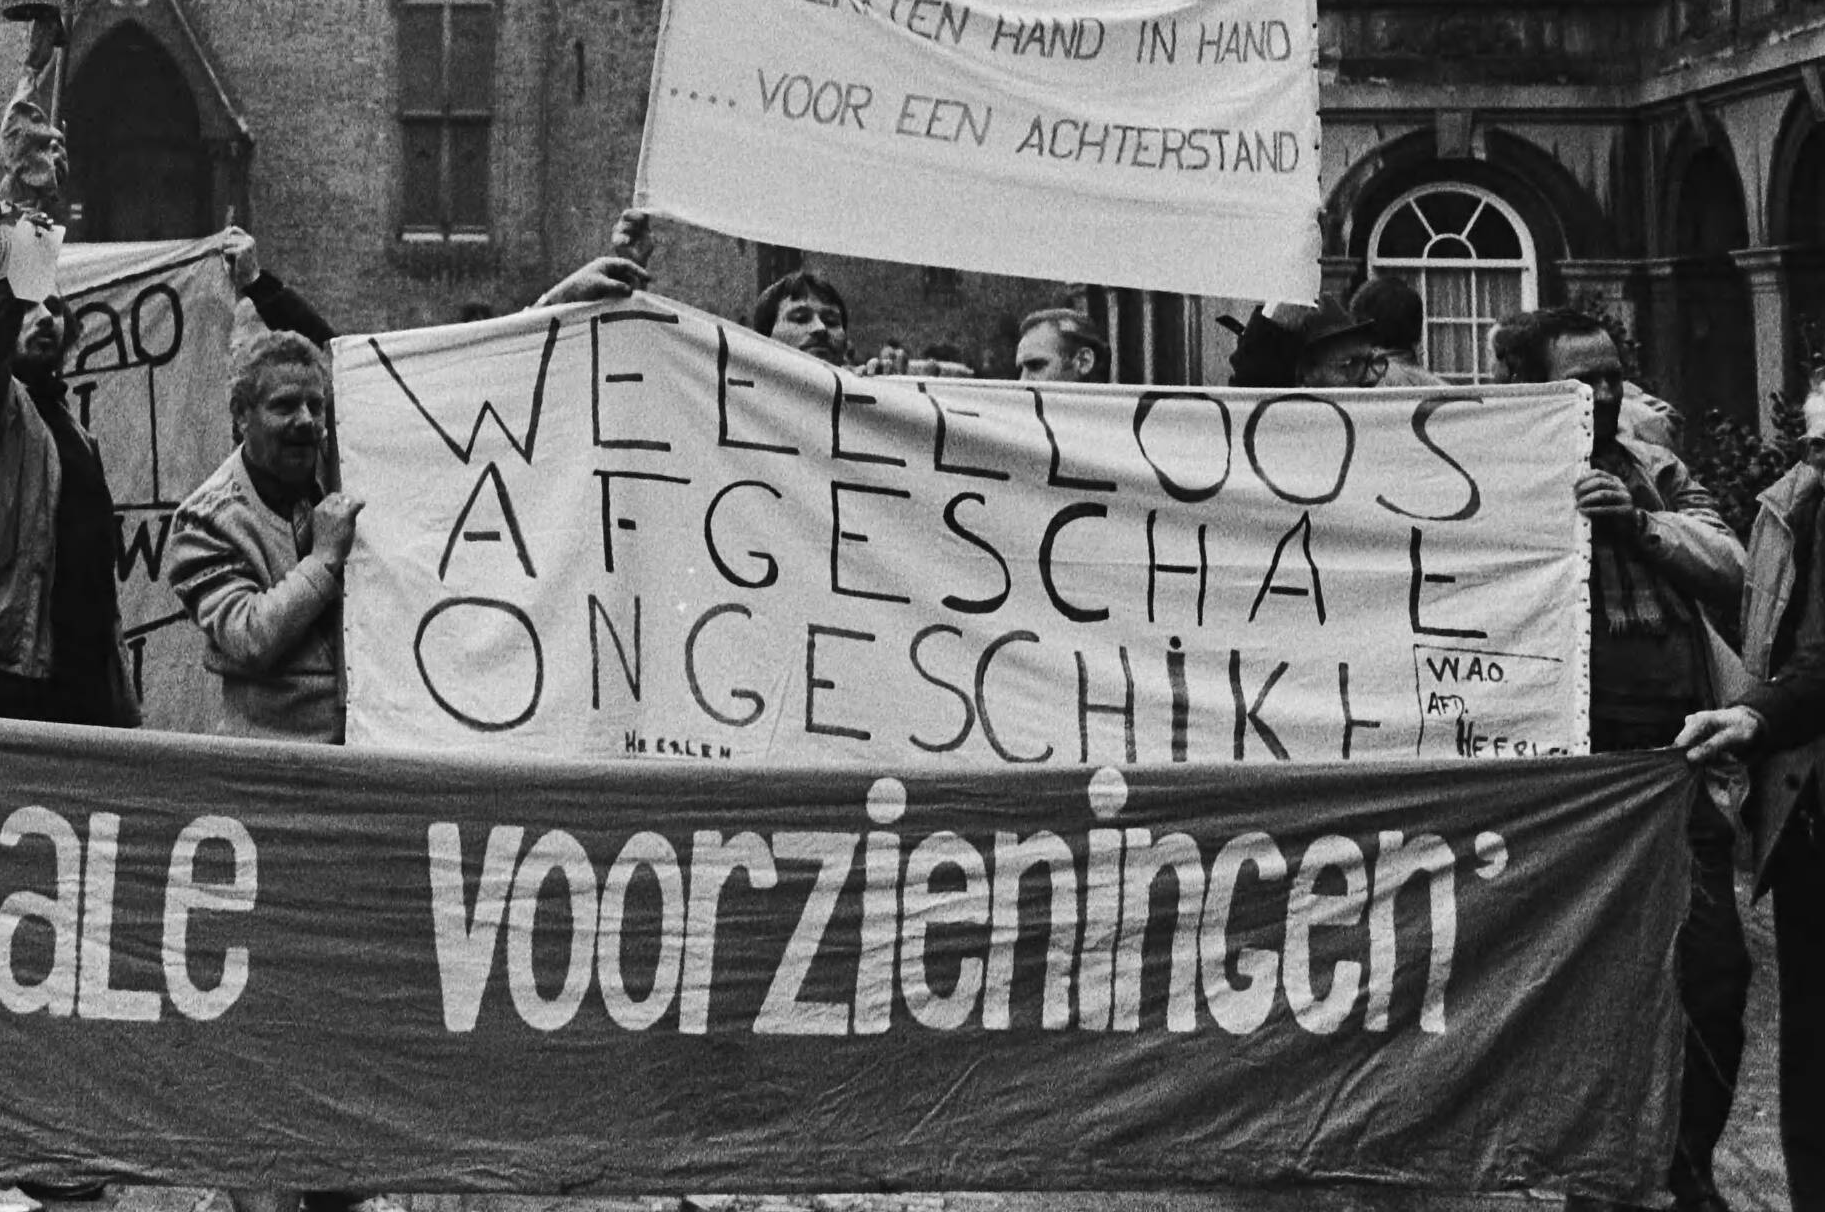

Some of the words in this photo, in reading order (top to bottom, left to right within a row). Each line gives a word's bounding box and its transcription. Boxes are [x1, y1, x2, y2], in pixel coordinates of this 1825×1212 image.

[990, 15, 1106, 61] HAND
[1136, 20, 1177, 65] IN
[1197, 19, 1292, 65] HAND
[895, 93, 992, 147] EEN
[1016, 116, 1300, 174] ACHTERSTAND
